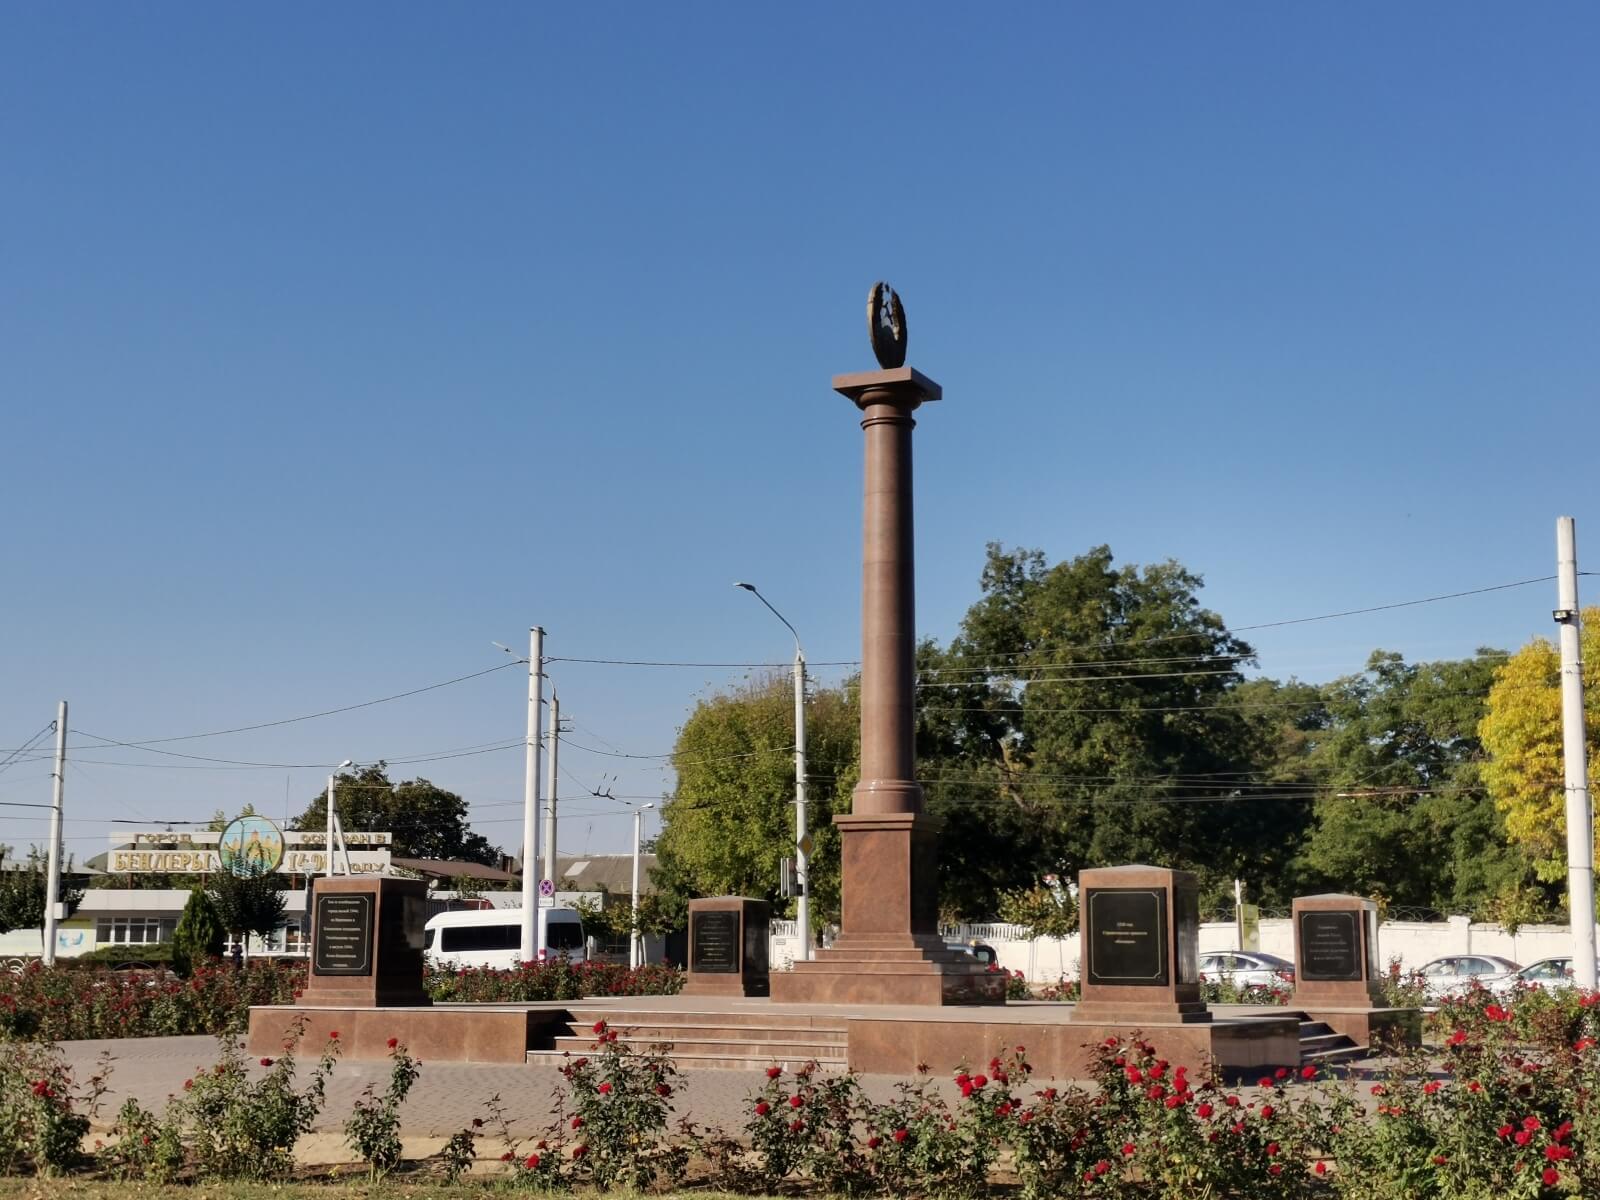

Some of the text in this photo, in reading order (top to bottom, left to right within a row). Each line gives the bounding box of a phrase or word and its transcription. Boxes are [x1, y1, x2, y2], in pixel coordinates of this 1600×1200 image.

[134, 832, 192, 843] ГОРОД
[374, 833, 386, 844] В
[114, 852, 212, 873] БЕНДЕРЫ
